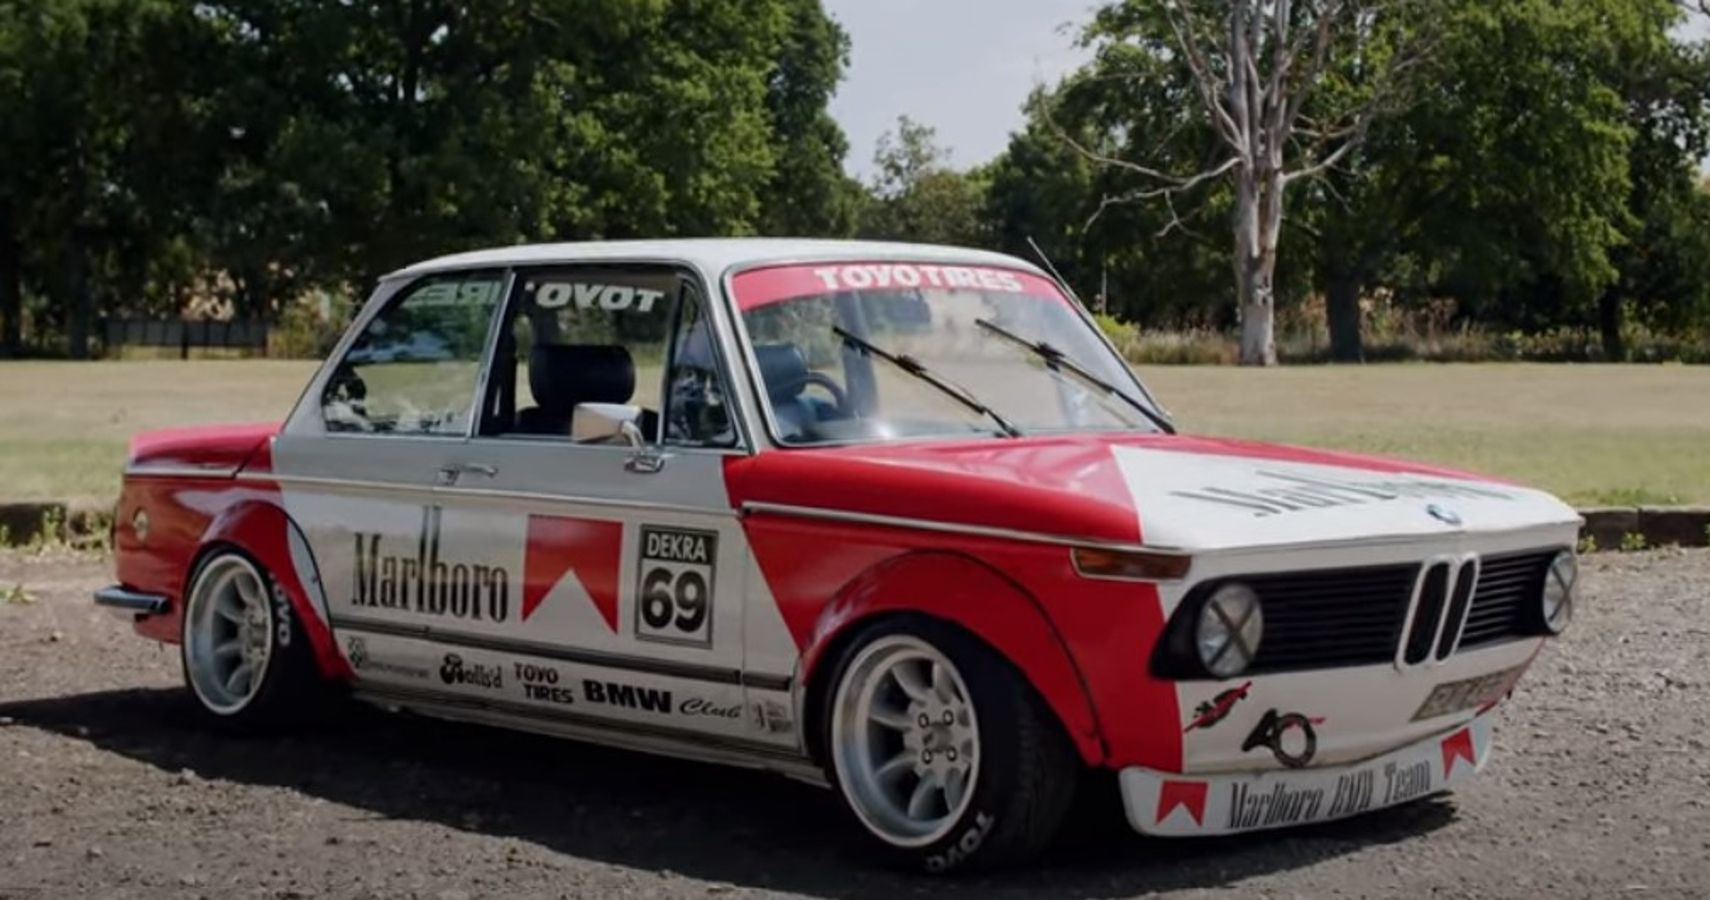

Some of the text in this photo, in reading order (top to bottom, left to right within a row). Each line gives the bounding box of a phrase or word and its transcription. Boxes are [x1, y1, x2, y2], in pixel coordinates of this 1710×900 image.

[351, 504, 509, 623] Marlboro
[646, 532, 708, 562] DEKRA
[268, 572, 292, 647] OYO
[641, 565, 708, 634] 69
[513, 661, 560, 685] TOYO
[523, 683, 575, 704] TIRES
[582, 679, 672, 714] BMW
[678, 697, 743, 719] Club
[1224, 781, 1325, 830] Marlboro
[1383, 759, 1431, 804] Team
[922, 811, 996, 873] TOYO
